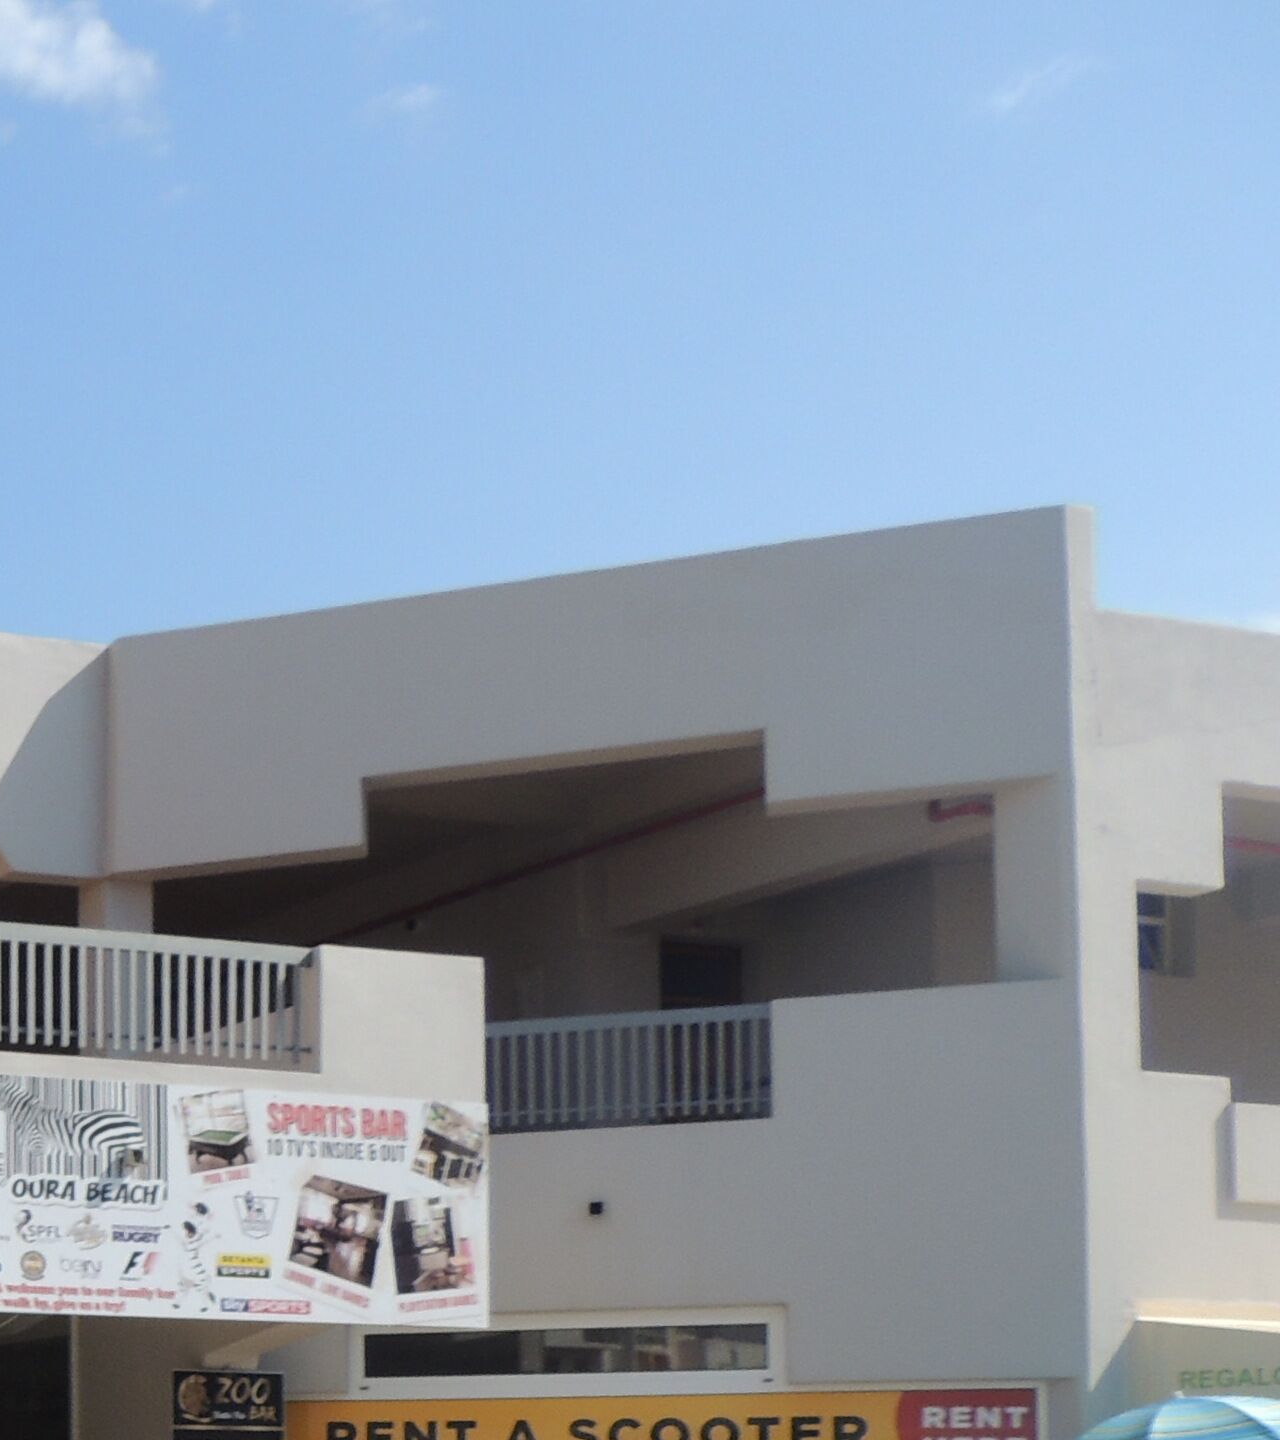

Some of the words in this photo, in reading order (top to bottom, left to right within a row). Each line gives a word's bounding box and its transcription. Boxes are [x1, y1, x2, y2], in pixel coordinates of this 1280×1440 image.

[266, 1102, 354, 1138] SPORTS
[361, 1107, 408, 1142] BAR
[267, 1138, 284, 1157] 10
[288, 1140, 318, 1158] TV'S
[321, 1141, 365, 1160] INSIDE
[381, 1144, 407, 1162] OUT
[12, 1179, 75, 1201] OURA
[86, 1181, 158, 1205] BEACH
[112, 1230, 161, 1244] RUGBY
[216, 1377, 271, 1405] ZOO
[921, 1405, 1028, 1430] RENT
